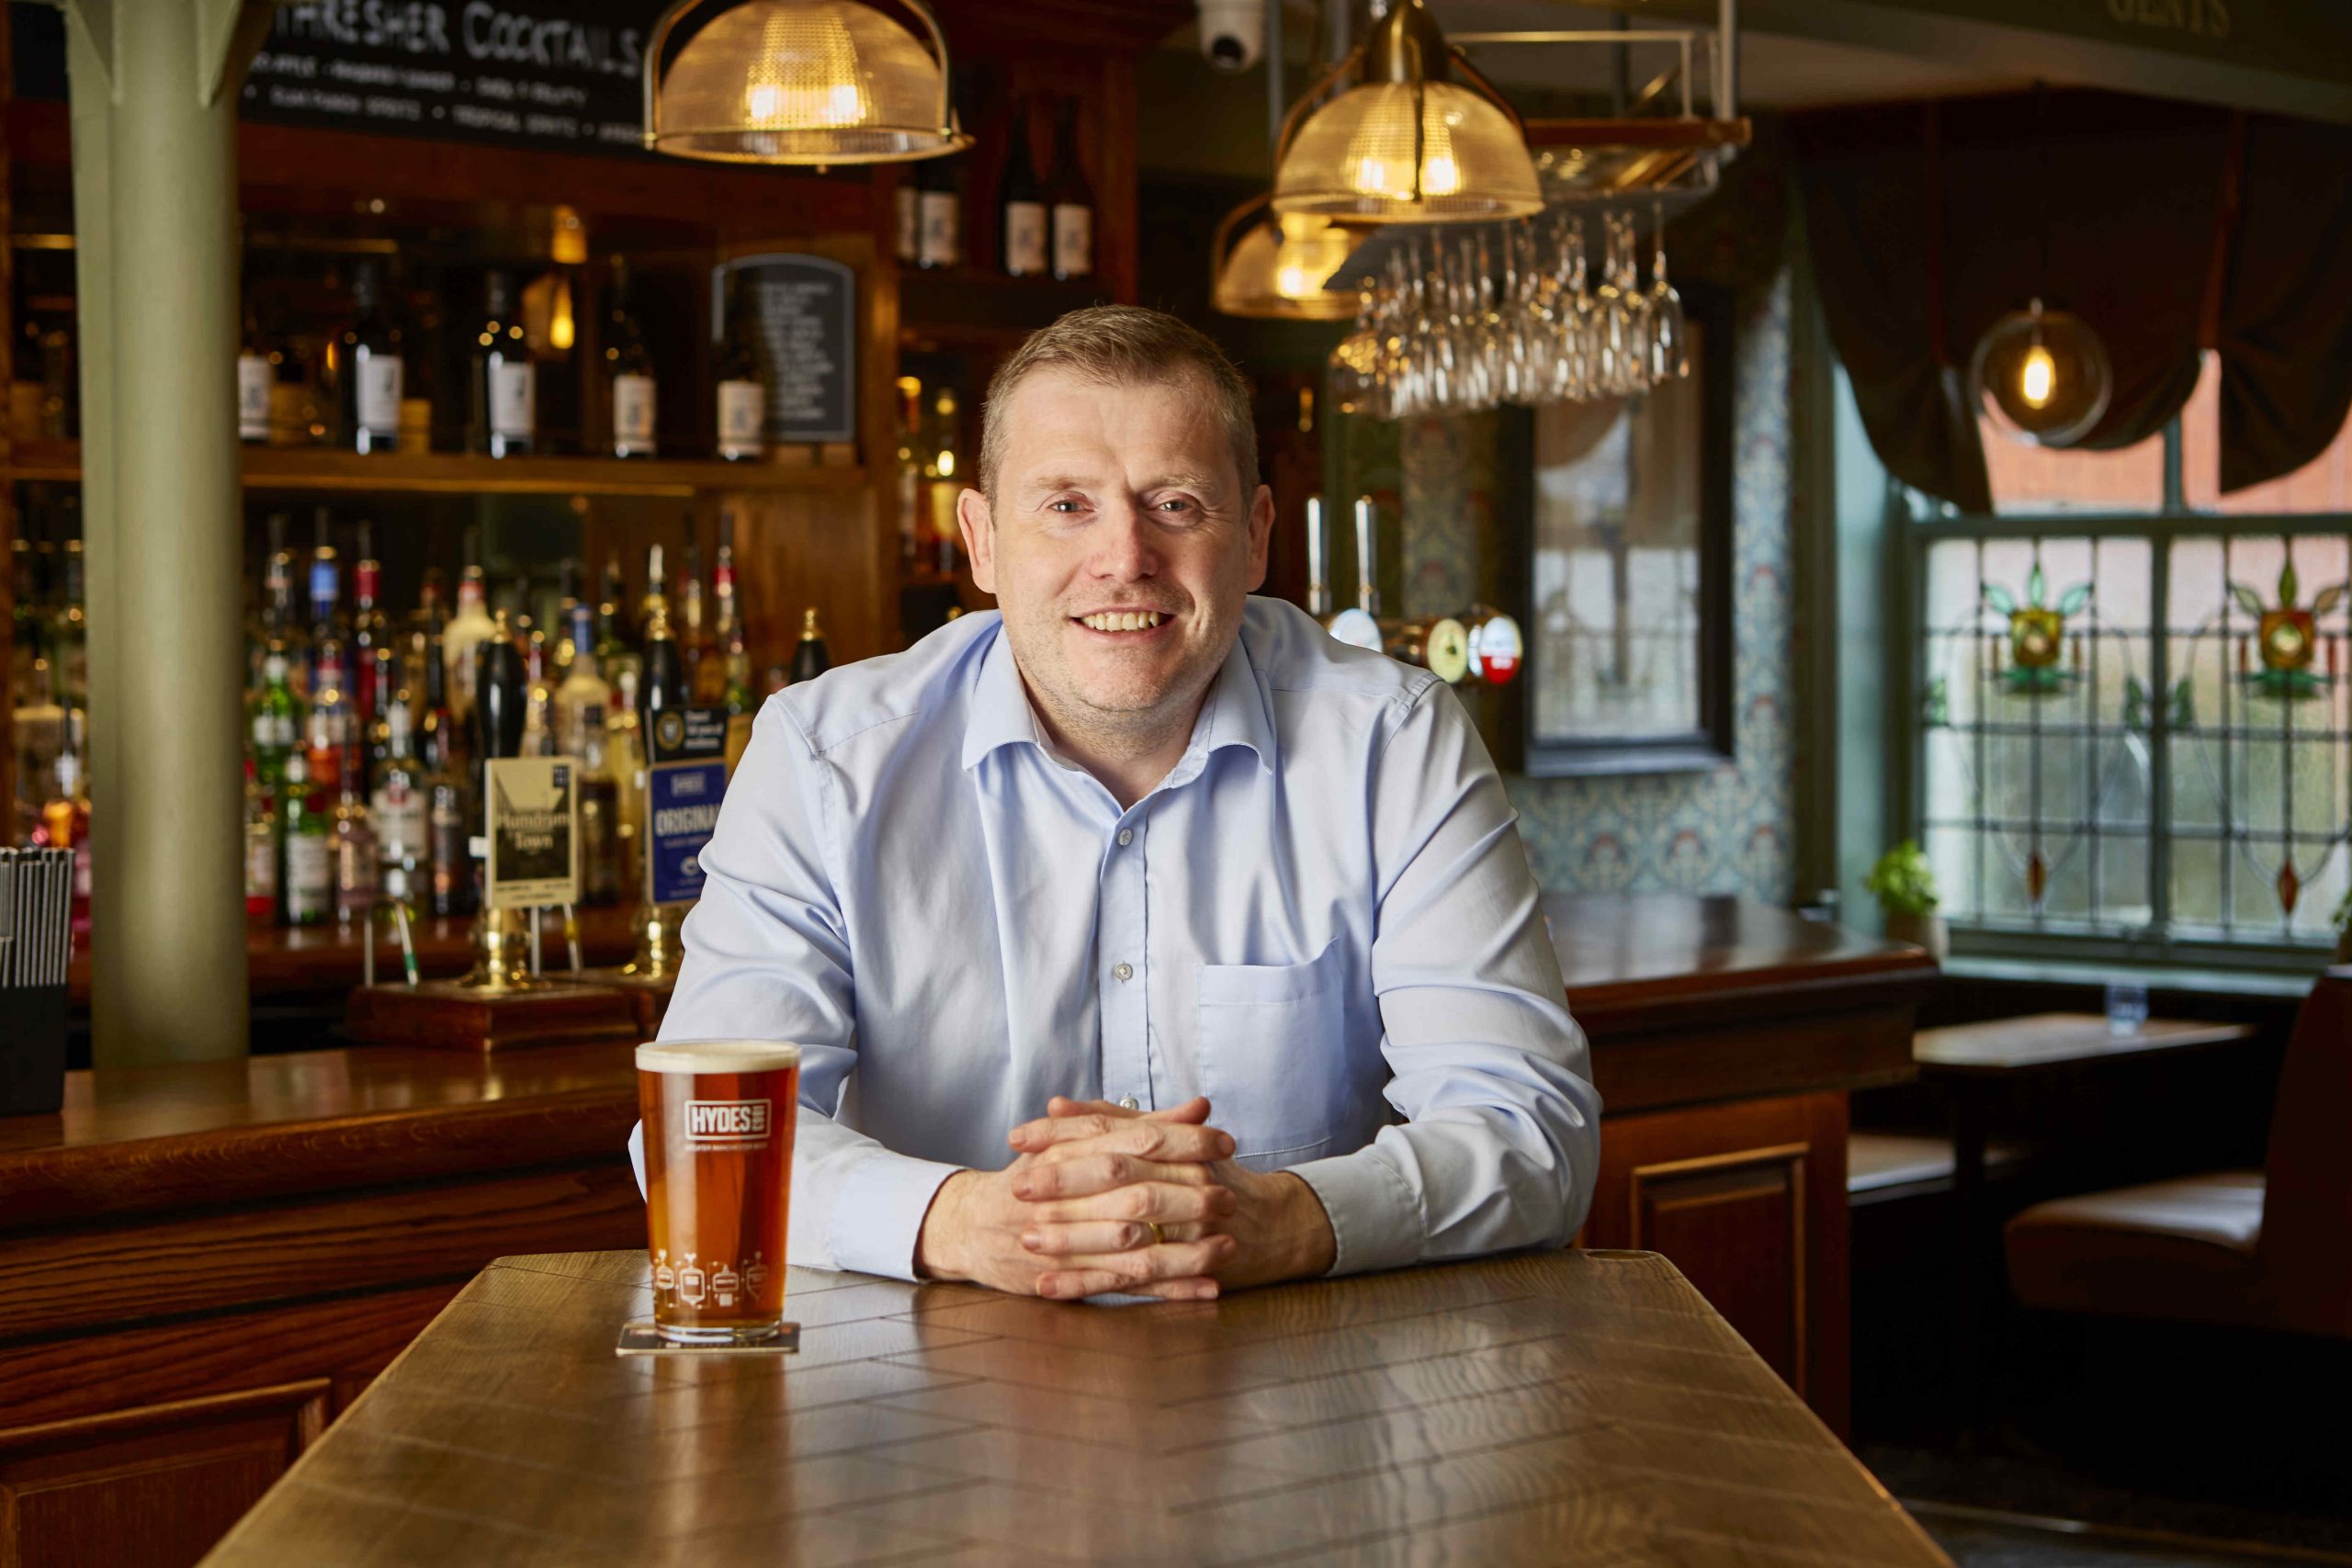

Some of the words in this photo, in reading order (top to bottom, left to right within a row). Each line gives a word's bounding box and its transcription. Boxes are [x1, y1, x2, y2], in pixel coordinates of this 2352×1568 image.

[463, 1, 640, 77] COCKTAILS
[655, 804, 721, 837] ORIGINA
[514, 830, 554, 851] Town
[691, 1106, 751, 1133] HYDES
